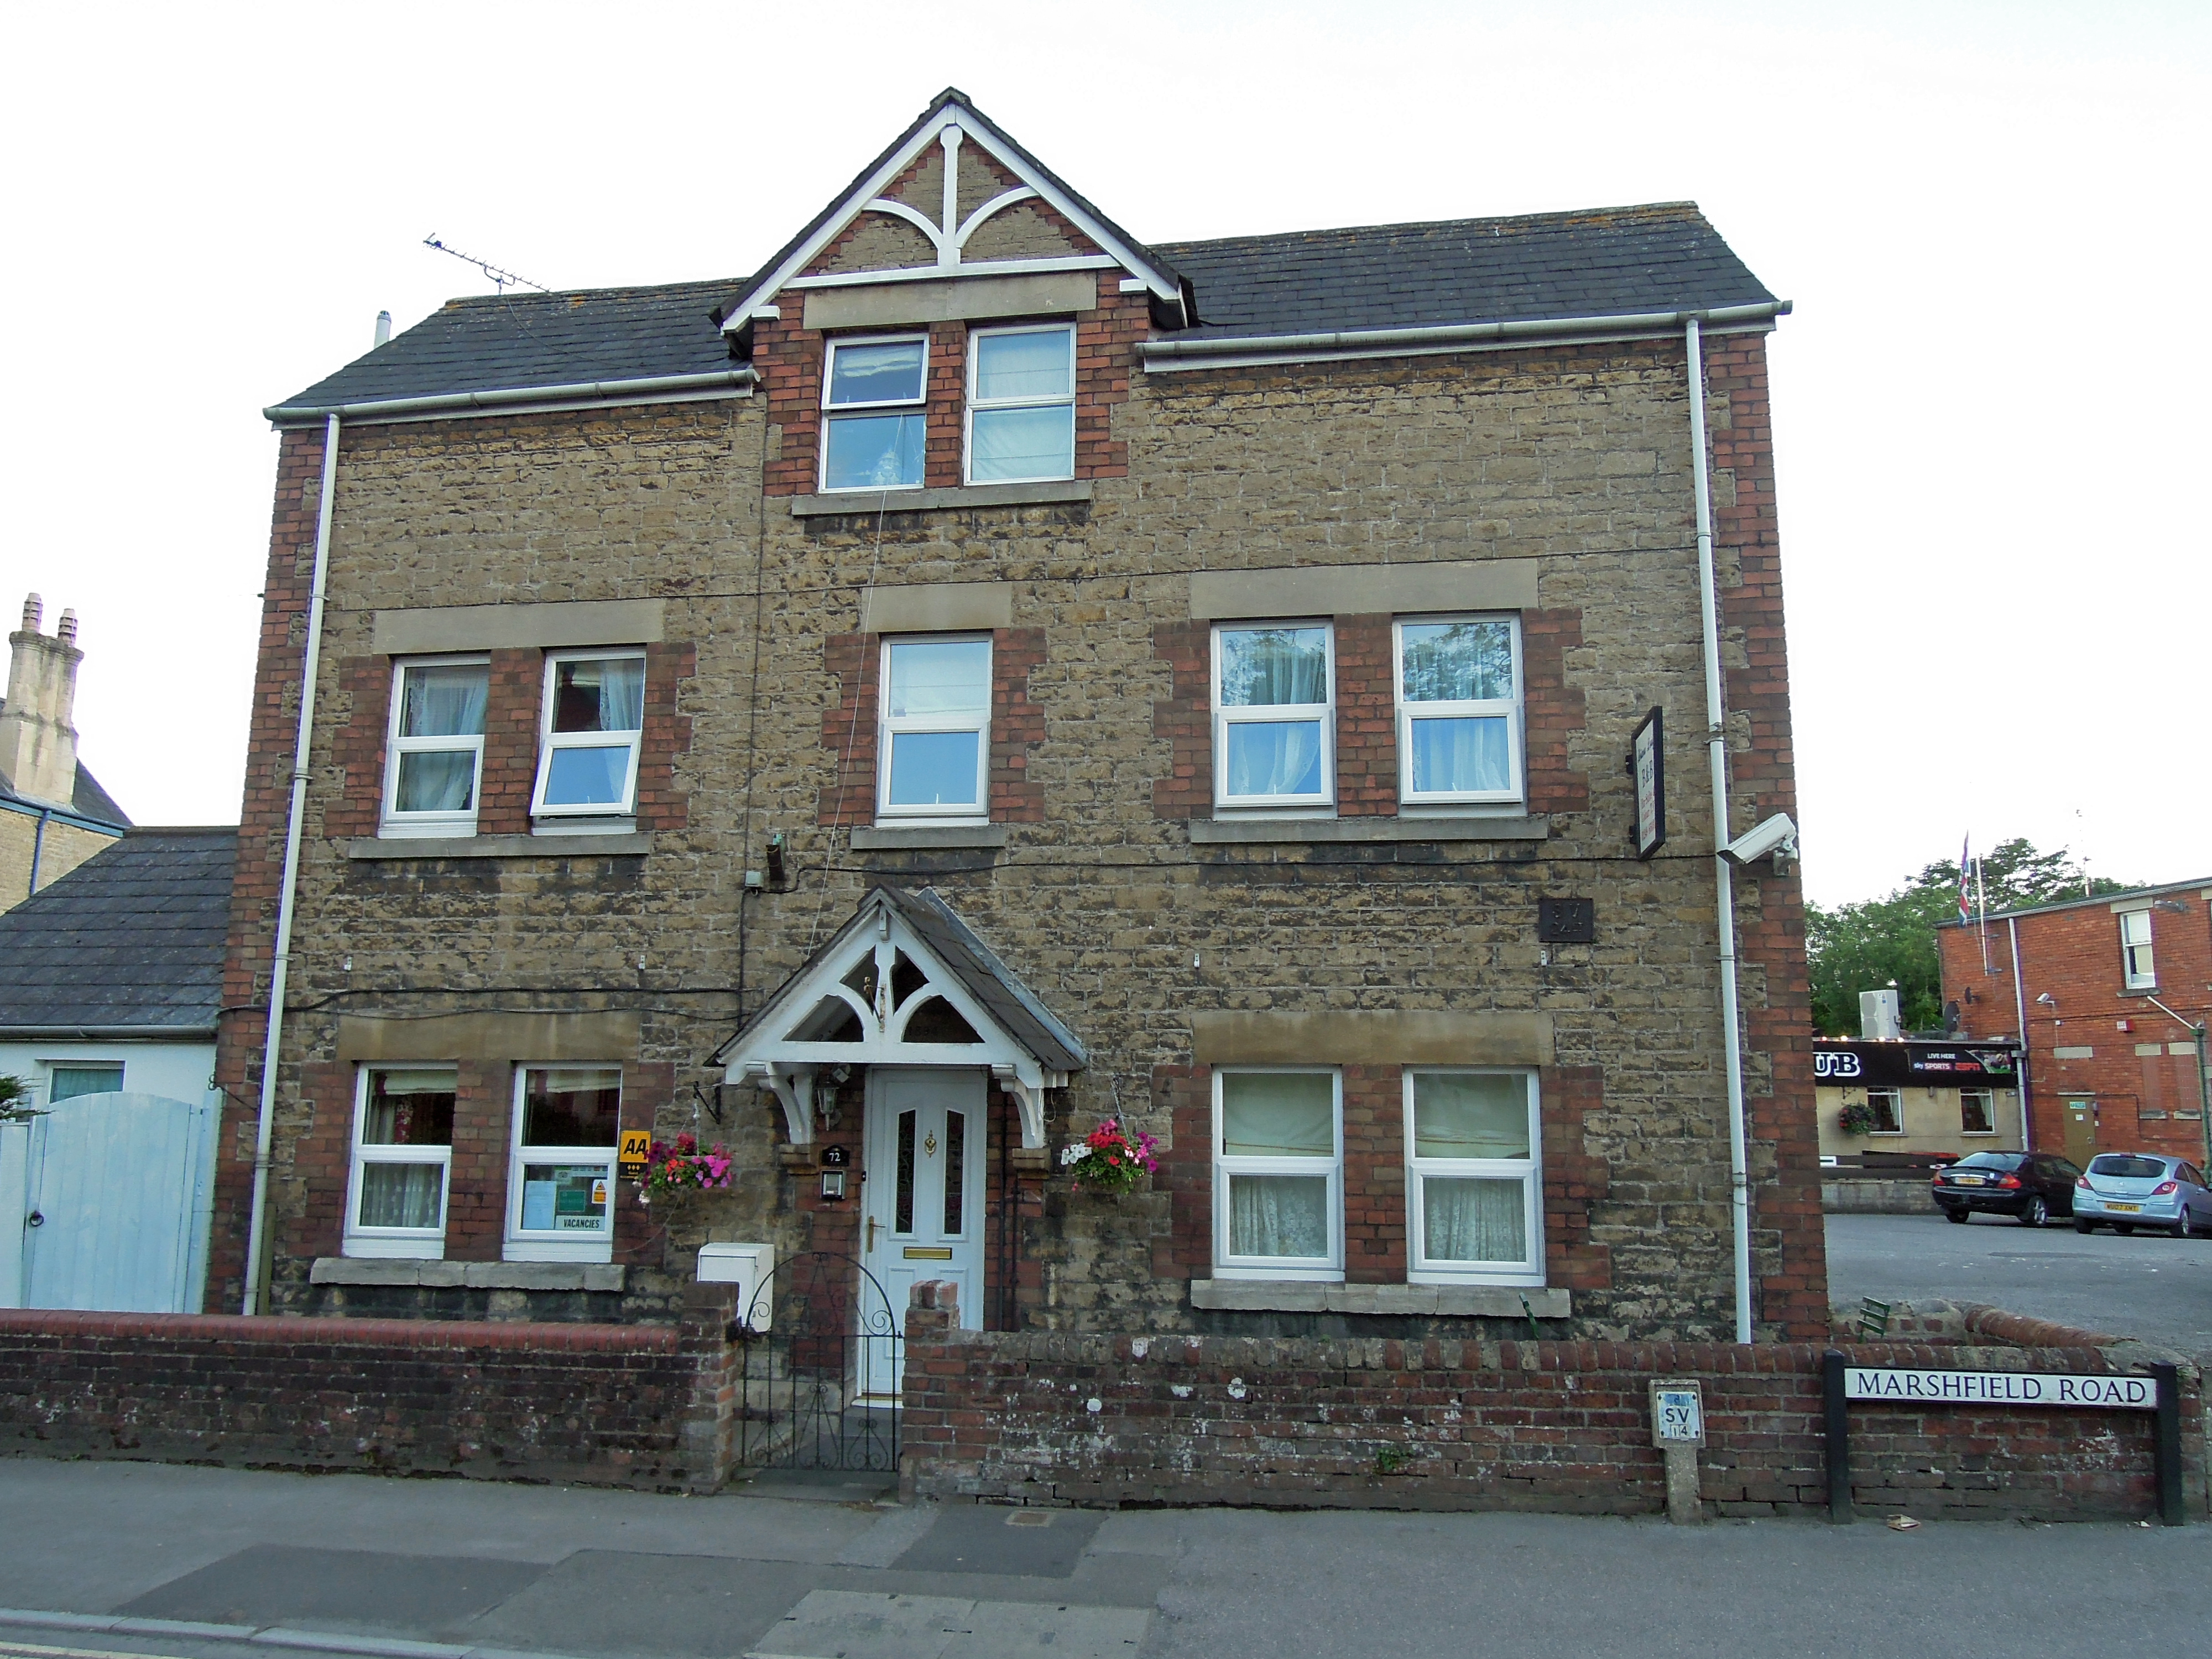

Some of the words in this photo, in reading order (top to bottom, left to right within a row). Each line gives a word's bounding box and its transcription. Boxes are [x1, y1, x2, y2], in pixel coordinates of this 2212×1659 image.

[1642, 760, 1653, 788] B&B
[1955, 1062, 1980, 1071] ESPN
[623, 1138, 647, 1155] AA
[829, 1152, 841, 1161] 72
[564, 1218, 599, 1228] VACANCIES
[1857, 1372, 2042, 1400] MARSHFIELD
[2059, 1379, 2146, 1403] ROAD
[1665, 1408, 1689, 1423] SV
[1673, 1426, 1687, 1436] 14
